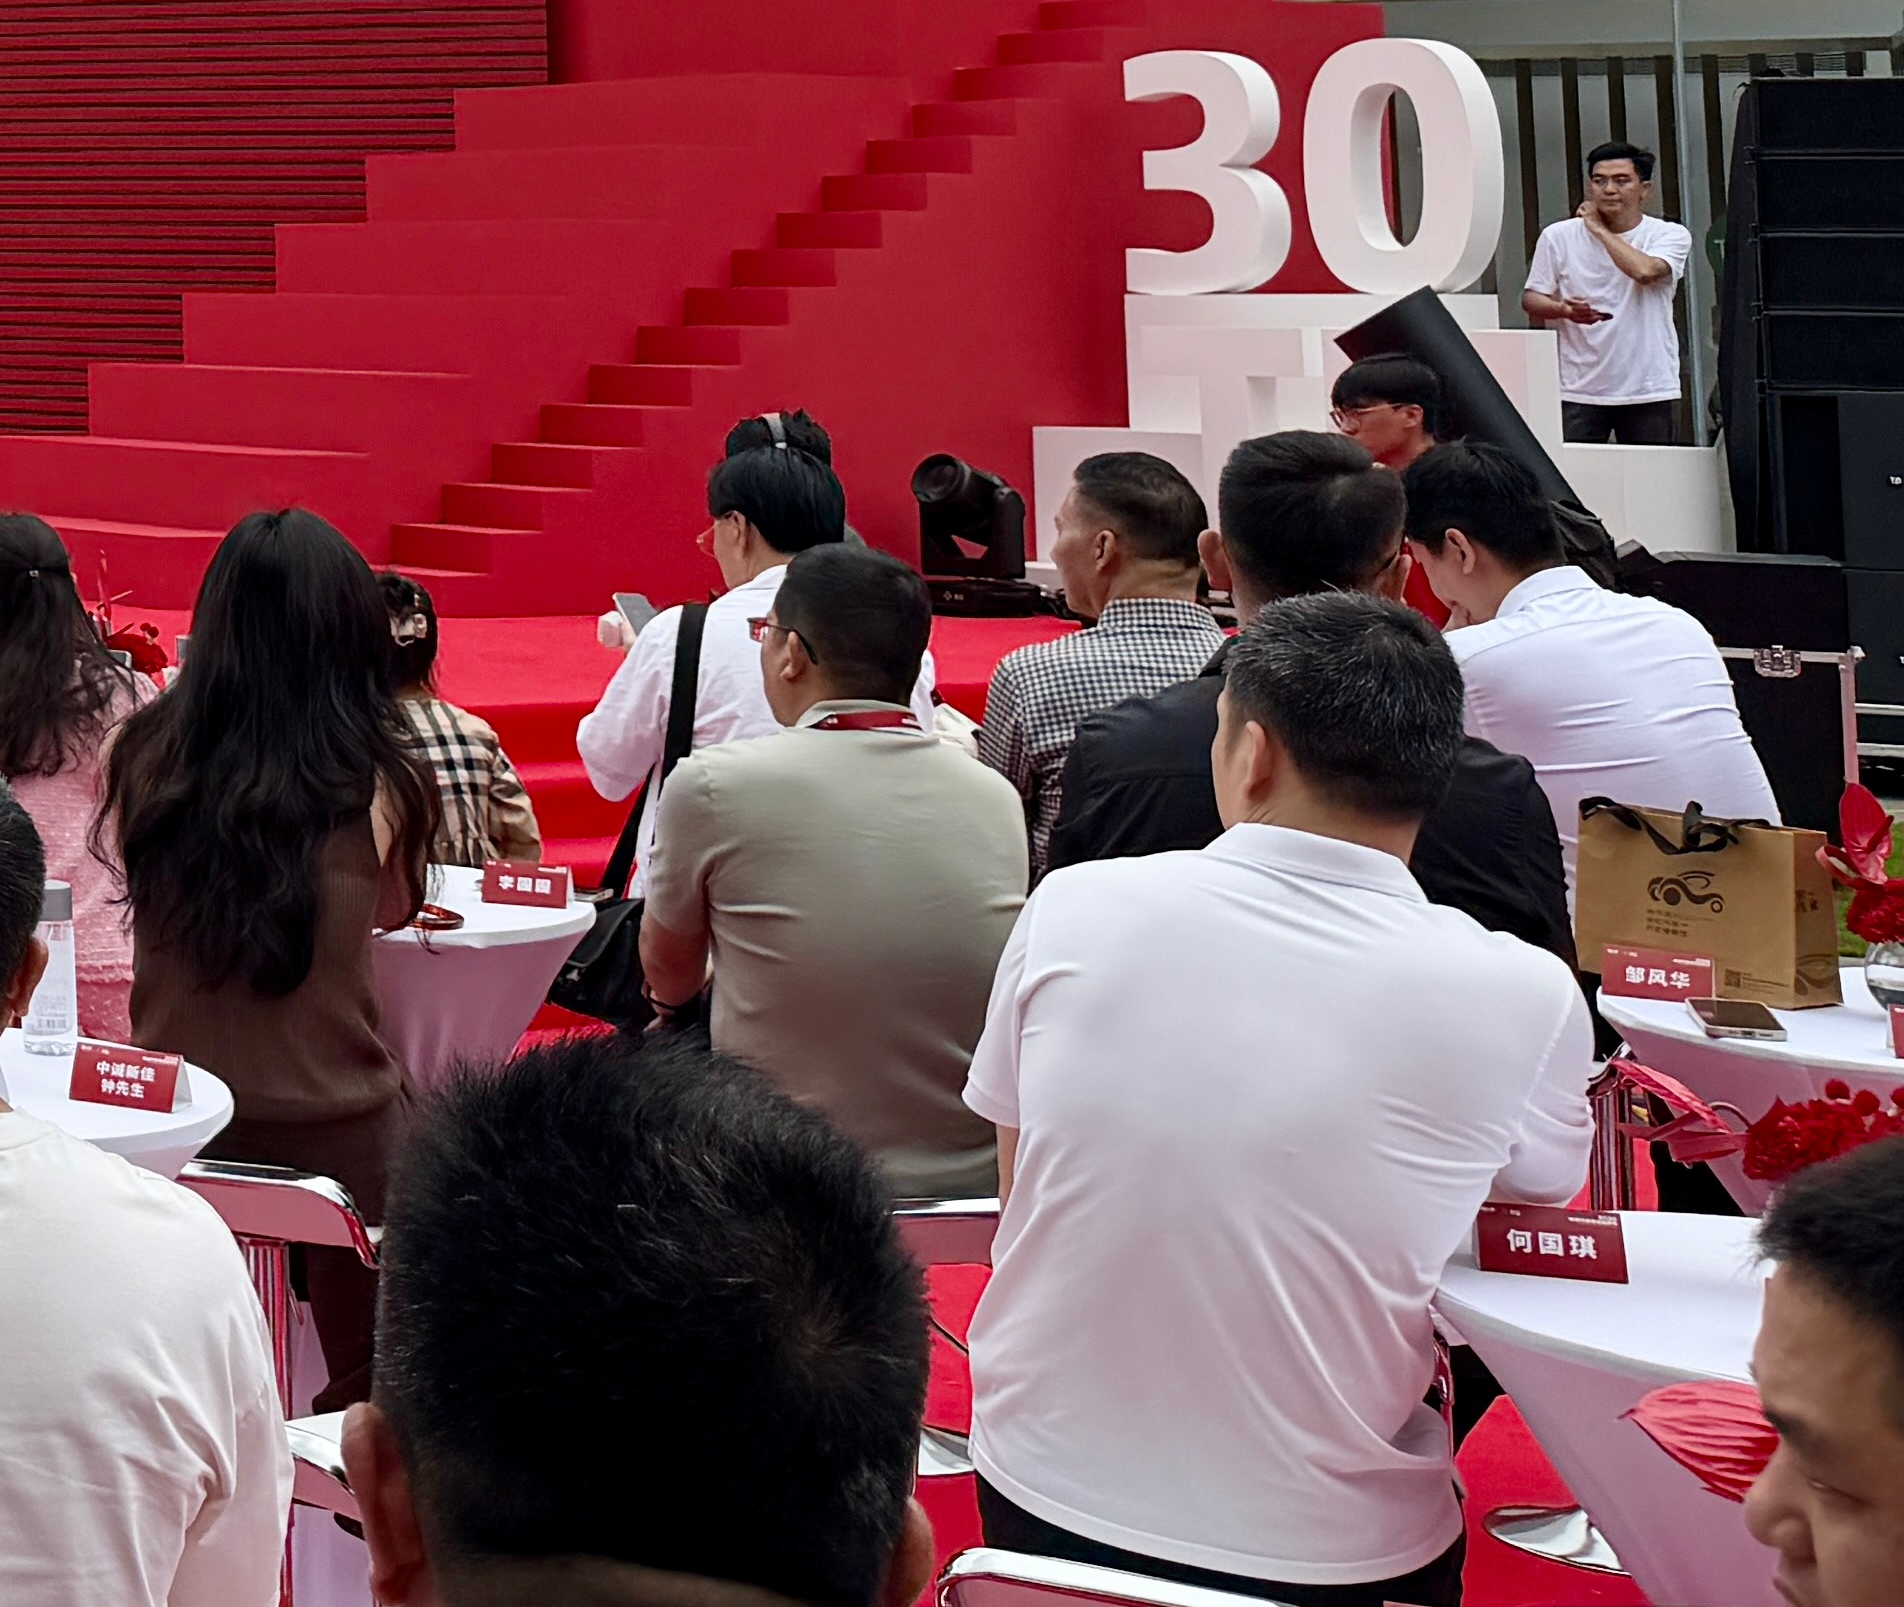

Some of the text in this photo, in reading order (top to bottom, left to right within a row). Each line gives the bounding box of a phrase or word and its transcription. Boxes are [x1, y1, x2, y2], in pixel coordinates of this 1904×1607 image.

[1123, 38, 1505, 295] 30
[1506, 1228, 1598, 1260] 何国琪
